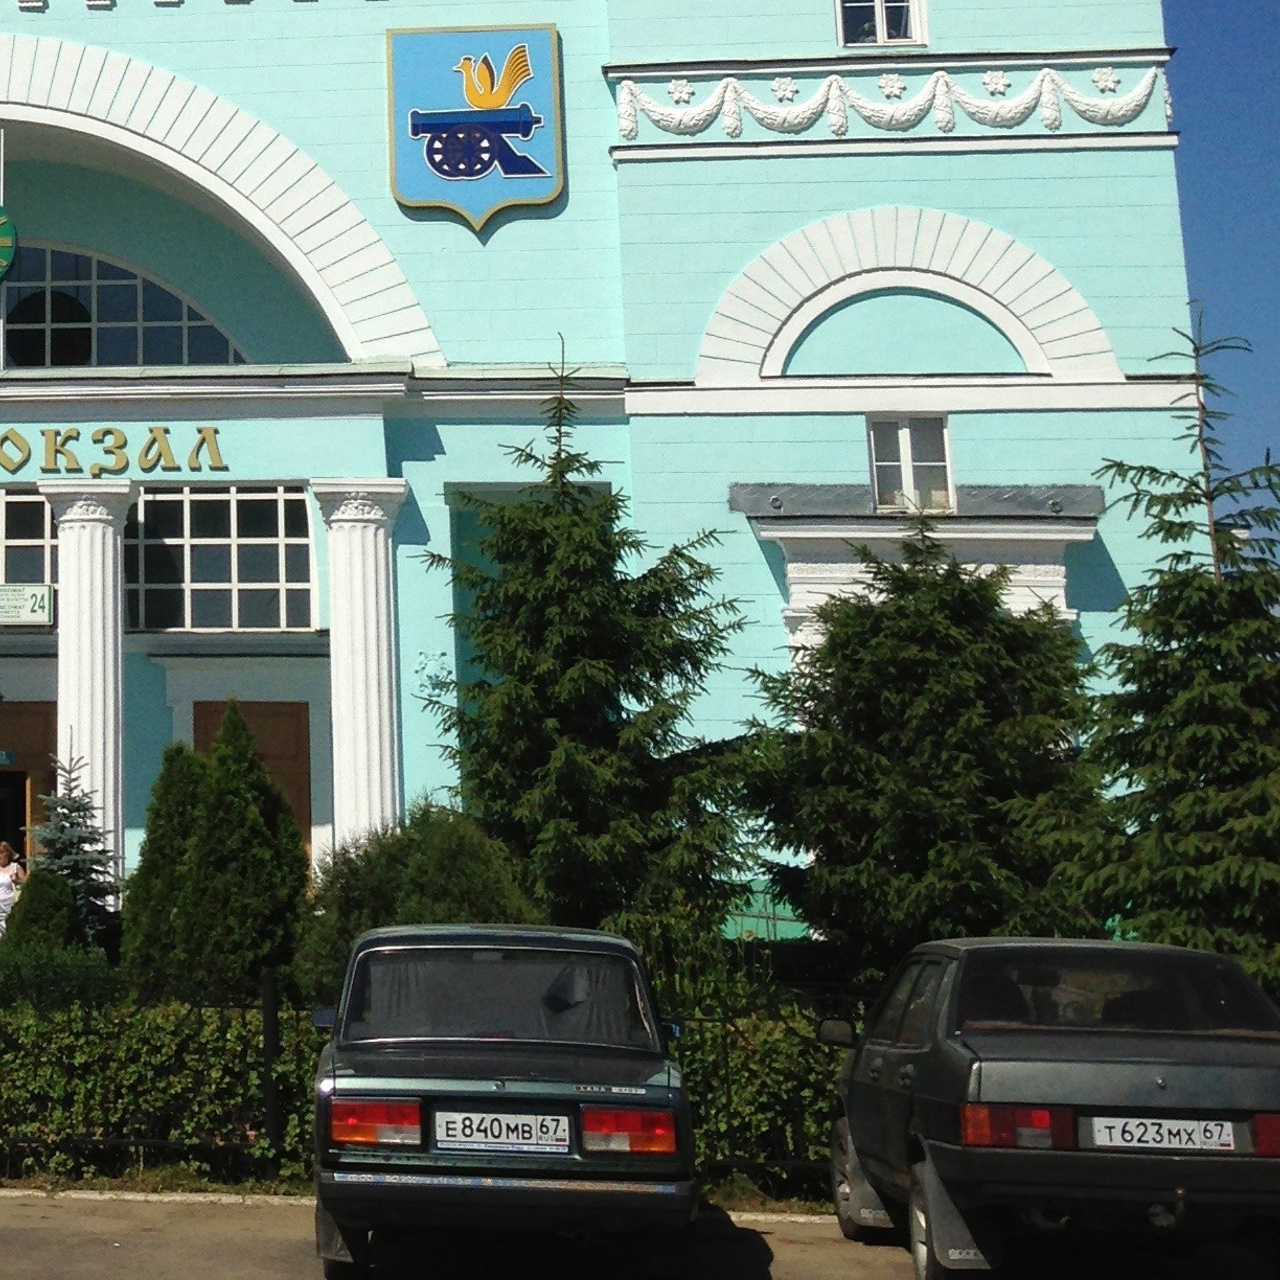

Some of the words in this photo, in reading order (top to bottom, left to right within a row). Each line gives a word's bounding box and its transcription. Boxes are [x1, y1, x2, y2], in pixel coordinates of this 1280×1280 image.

[30, 593, 46, 613] 24
[539, 1118, 561, 1135] 67
[1202, 1122, 1225, 1140] 67
